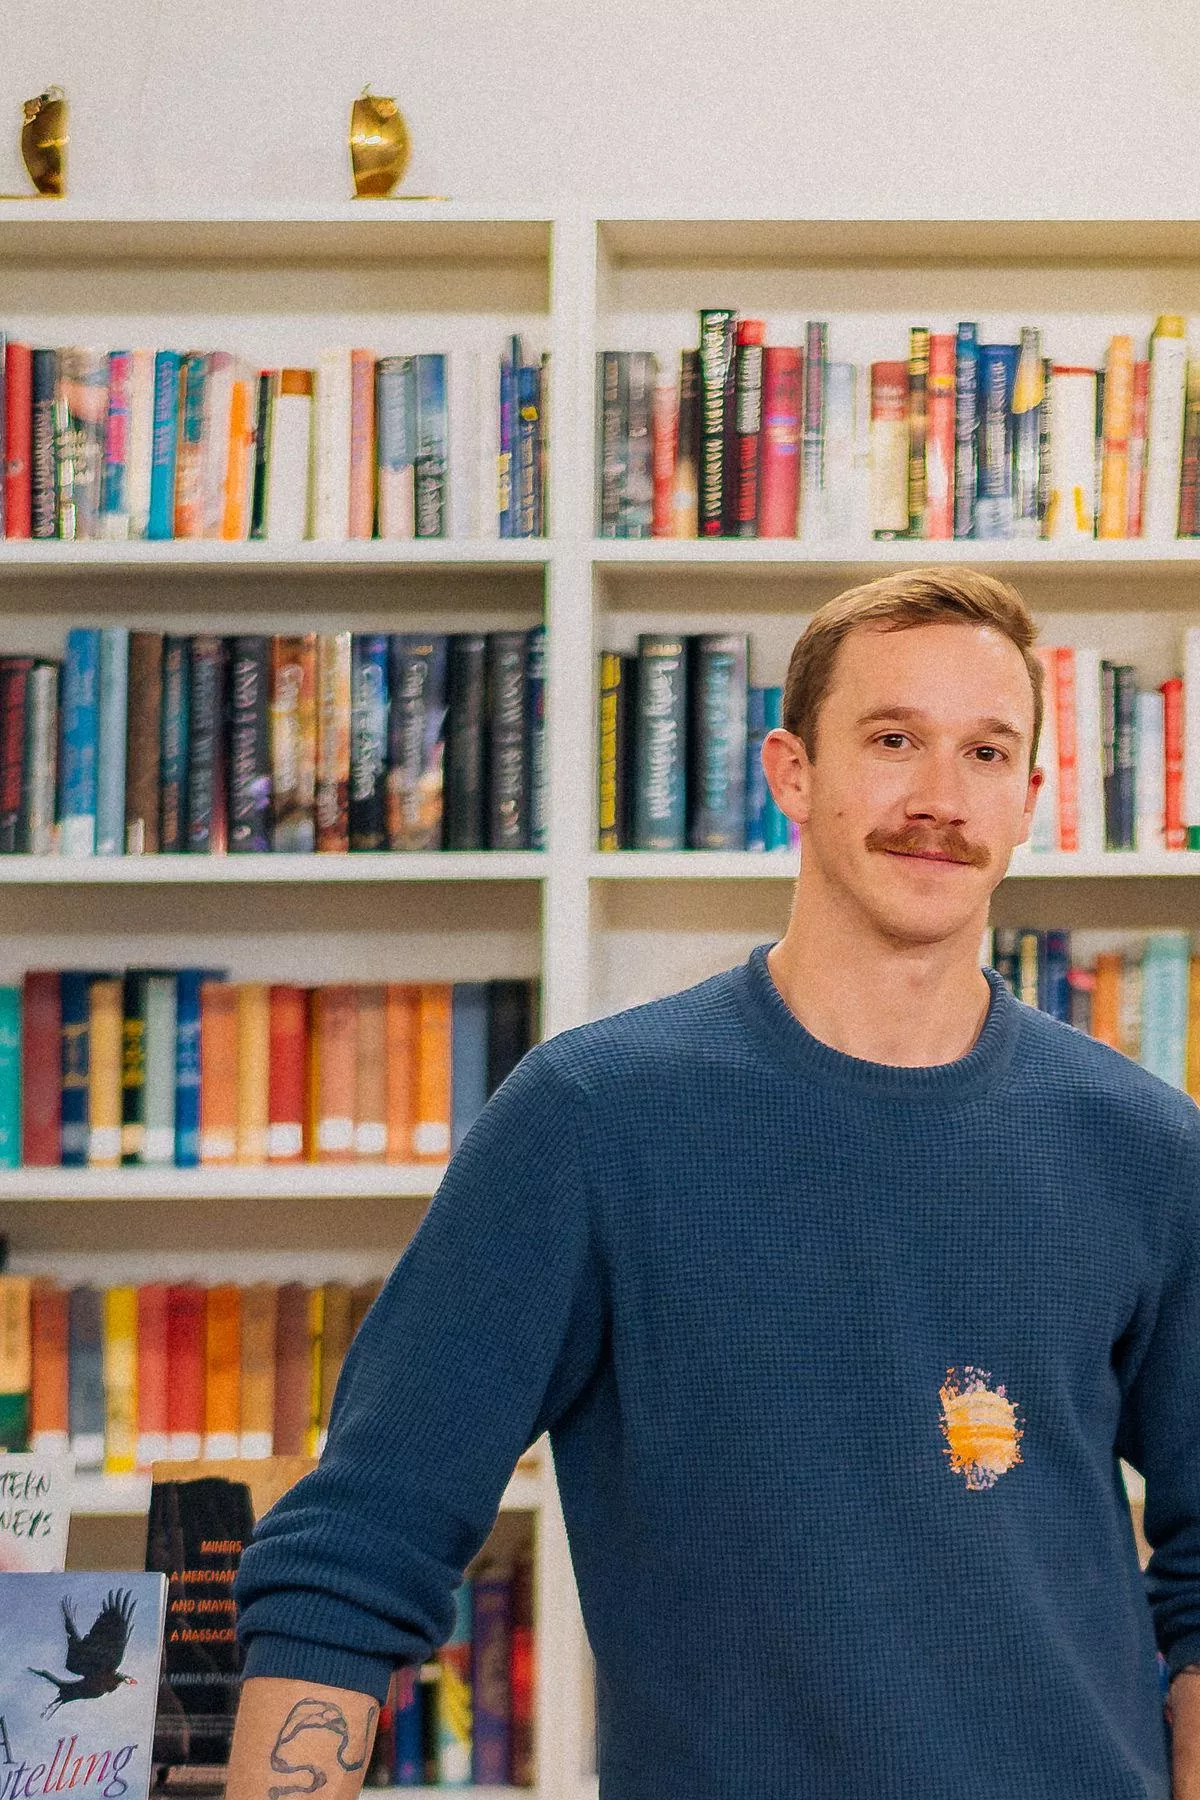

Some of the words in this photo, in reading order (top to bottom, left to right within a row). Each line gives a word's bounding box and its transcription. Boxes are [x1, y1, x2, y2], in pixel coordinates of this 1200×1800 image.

[171, 1571, 179, 1582] A
[171, 1600, 195, 1612] AND
[171, 1629, 179, 1641] A
